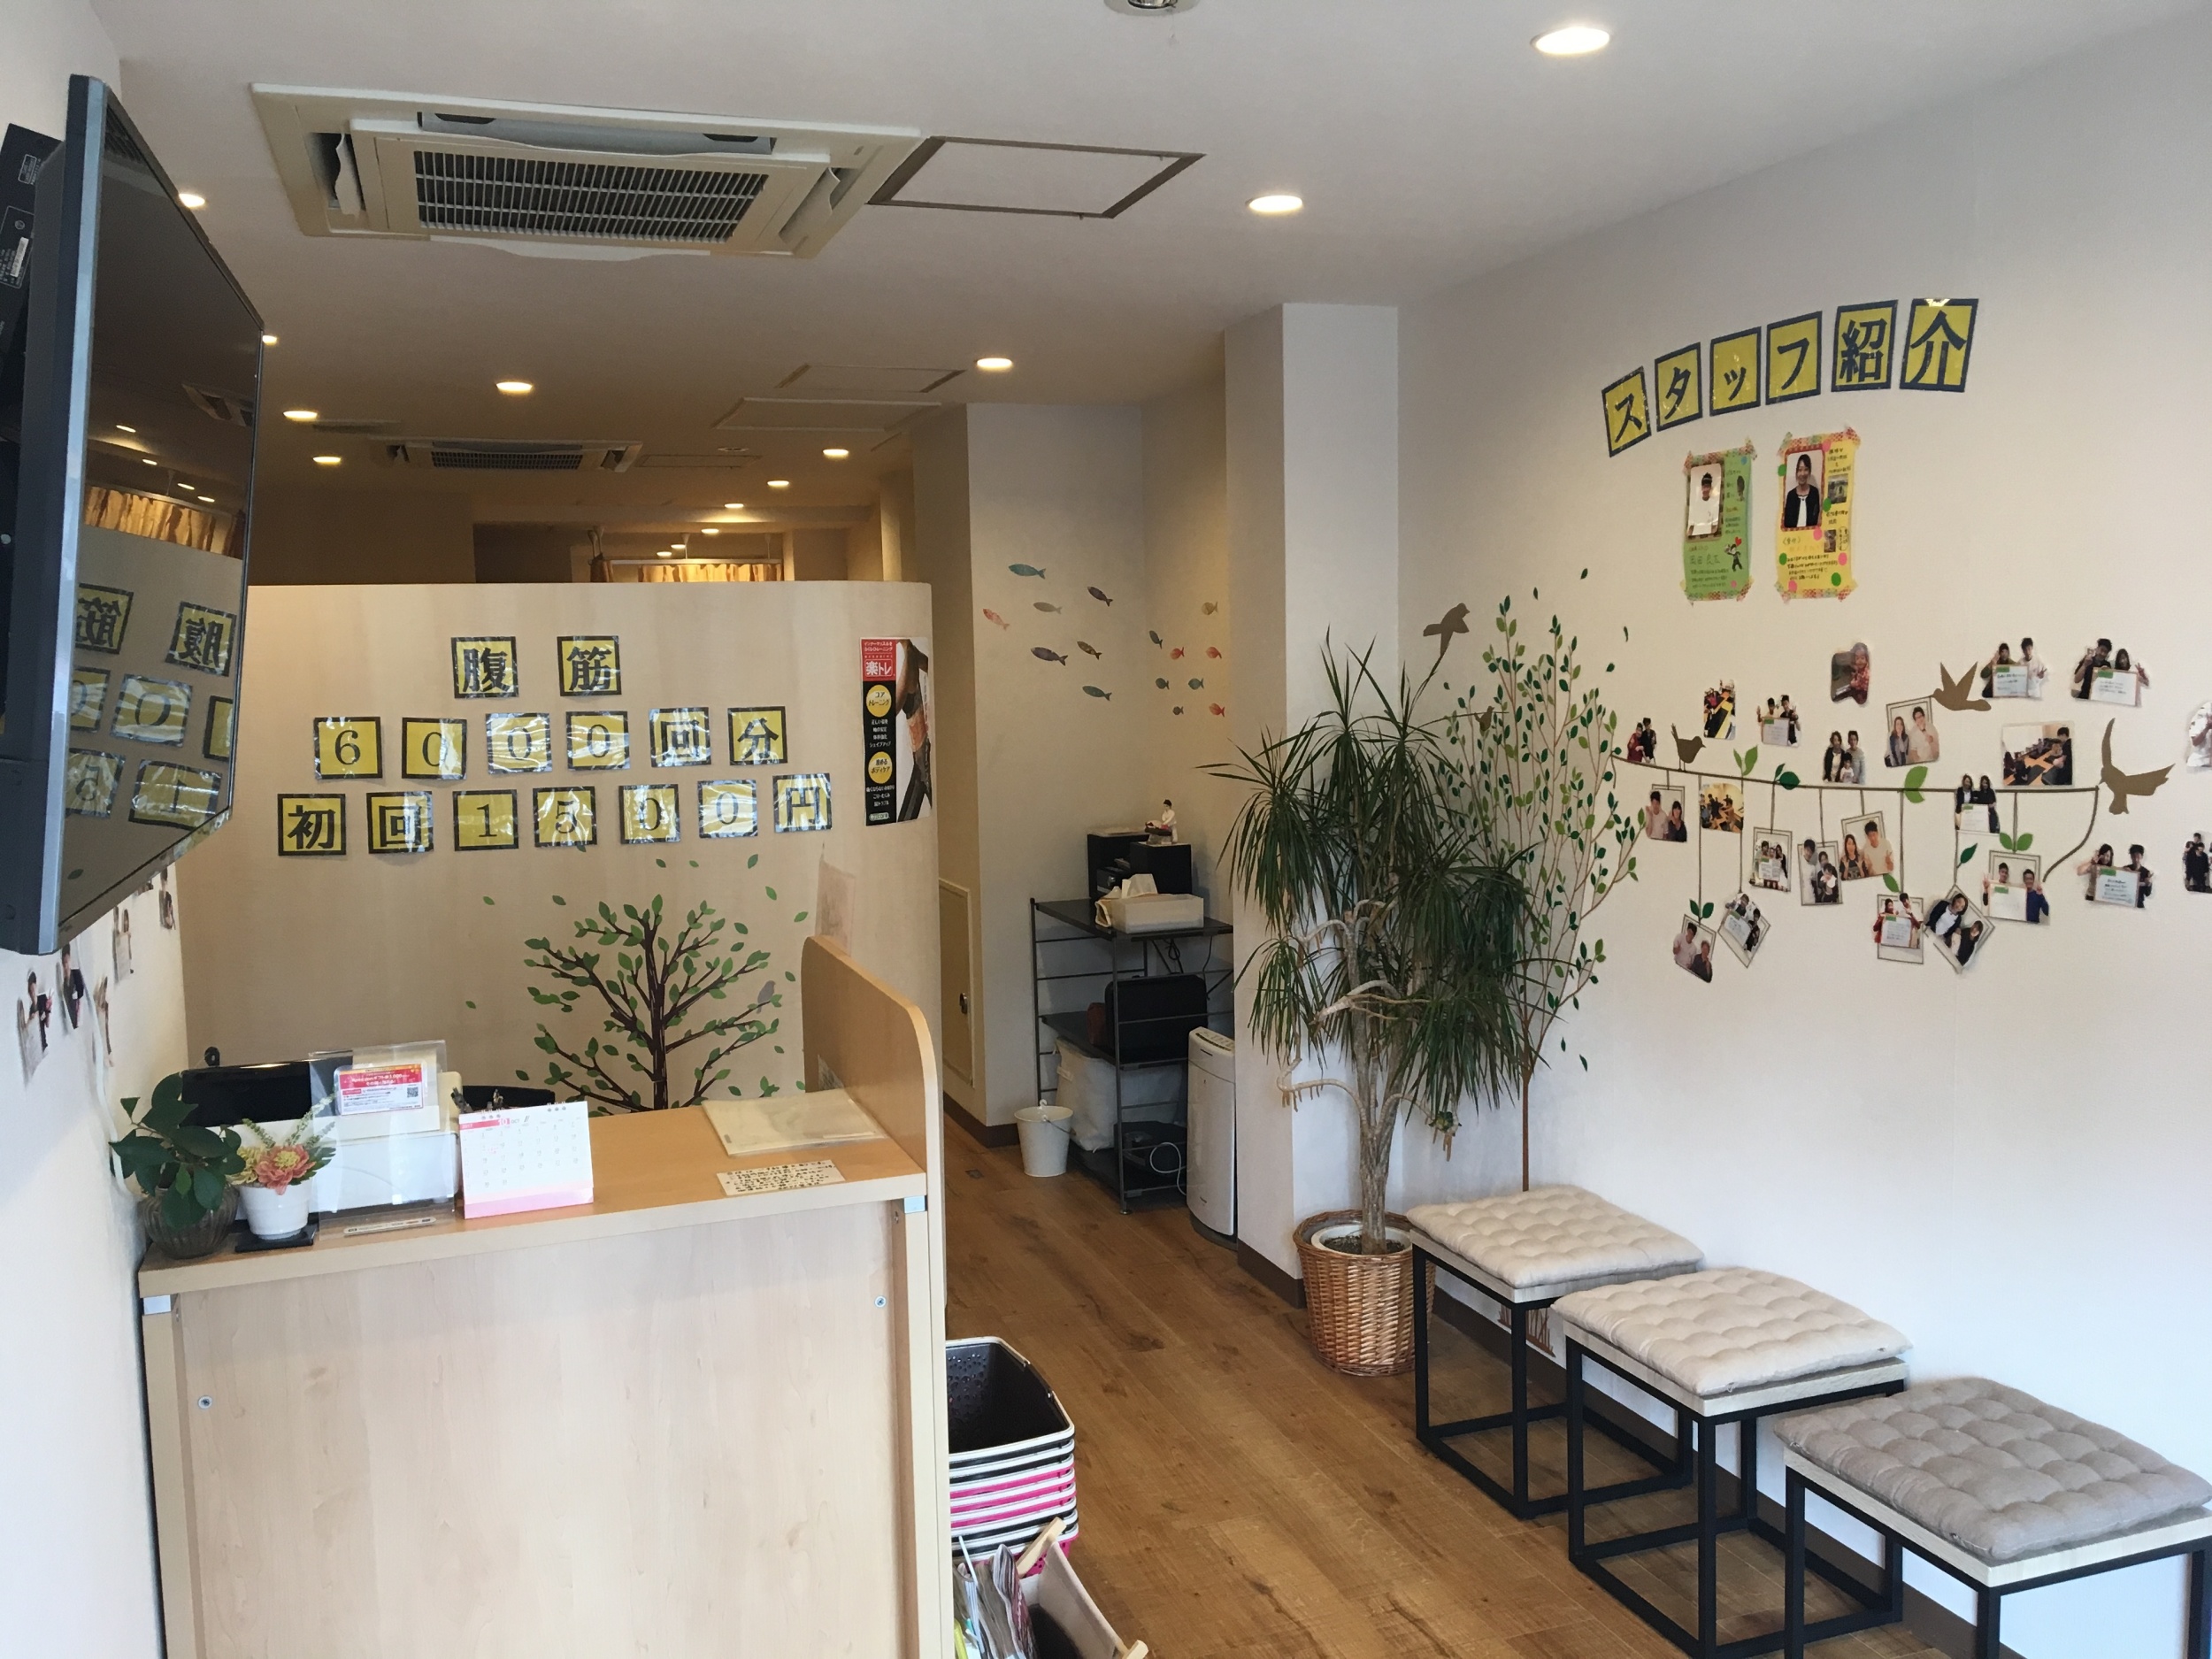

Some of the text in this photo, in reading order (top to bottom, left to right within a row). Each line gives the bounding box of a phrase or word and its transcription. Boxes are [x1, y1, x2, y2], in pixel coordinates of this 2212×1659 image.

[1615, 311, 1967, 442] スタッフ紹介
[460, 644, 613, 694] 腹筋
[866, 660, 892, 676] 楽トレ
[334, 715, 782, 769] 6000回分
[287, 785, 825, 851] 初回1500円
